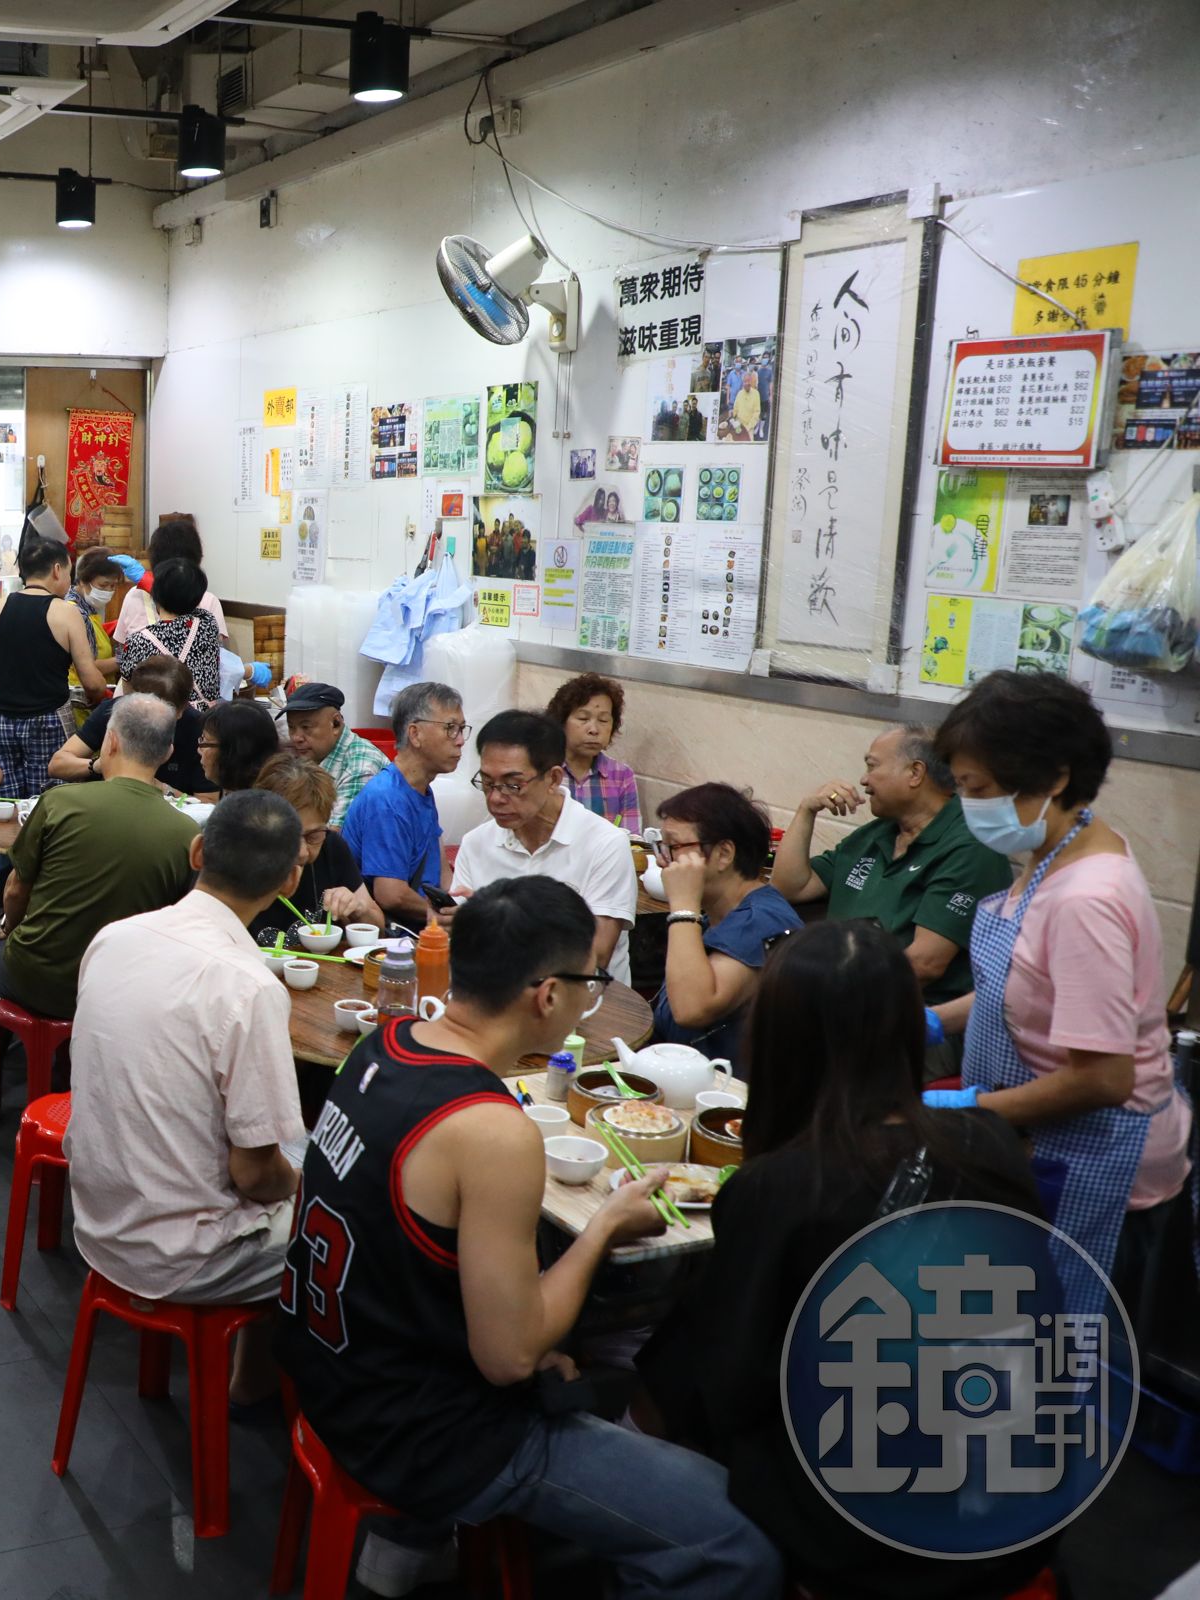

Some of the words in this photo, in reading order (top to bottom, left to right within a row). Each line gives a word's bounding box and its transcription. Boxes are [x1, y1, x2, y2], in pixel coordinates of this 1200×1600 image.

[618, 315, 701, 357] 滋味重現
[985, 356, 1057, 370] 是日蒸魚飯套餐
[995, 397, 1010, 405] $70
[1072, 394, 1087, 403] $70
[266, 396, 294, 418] 外賣部
[1070, 406, 1085, 415] $22
[1016, 419, 1032, 427] 白飯
[1068, 418, 1083, 426] $15
[81, 432, 119, 447] 財神到
